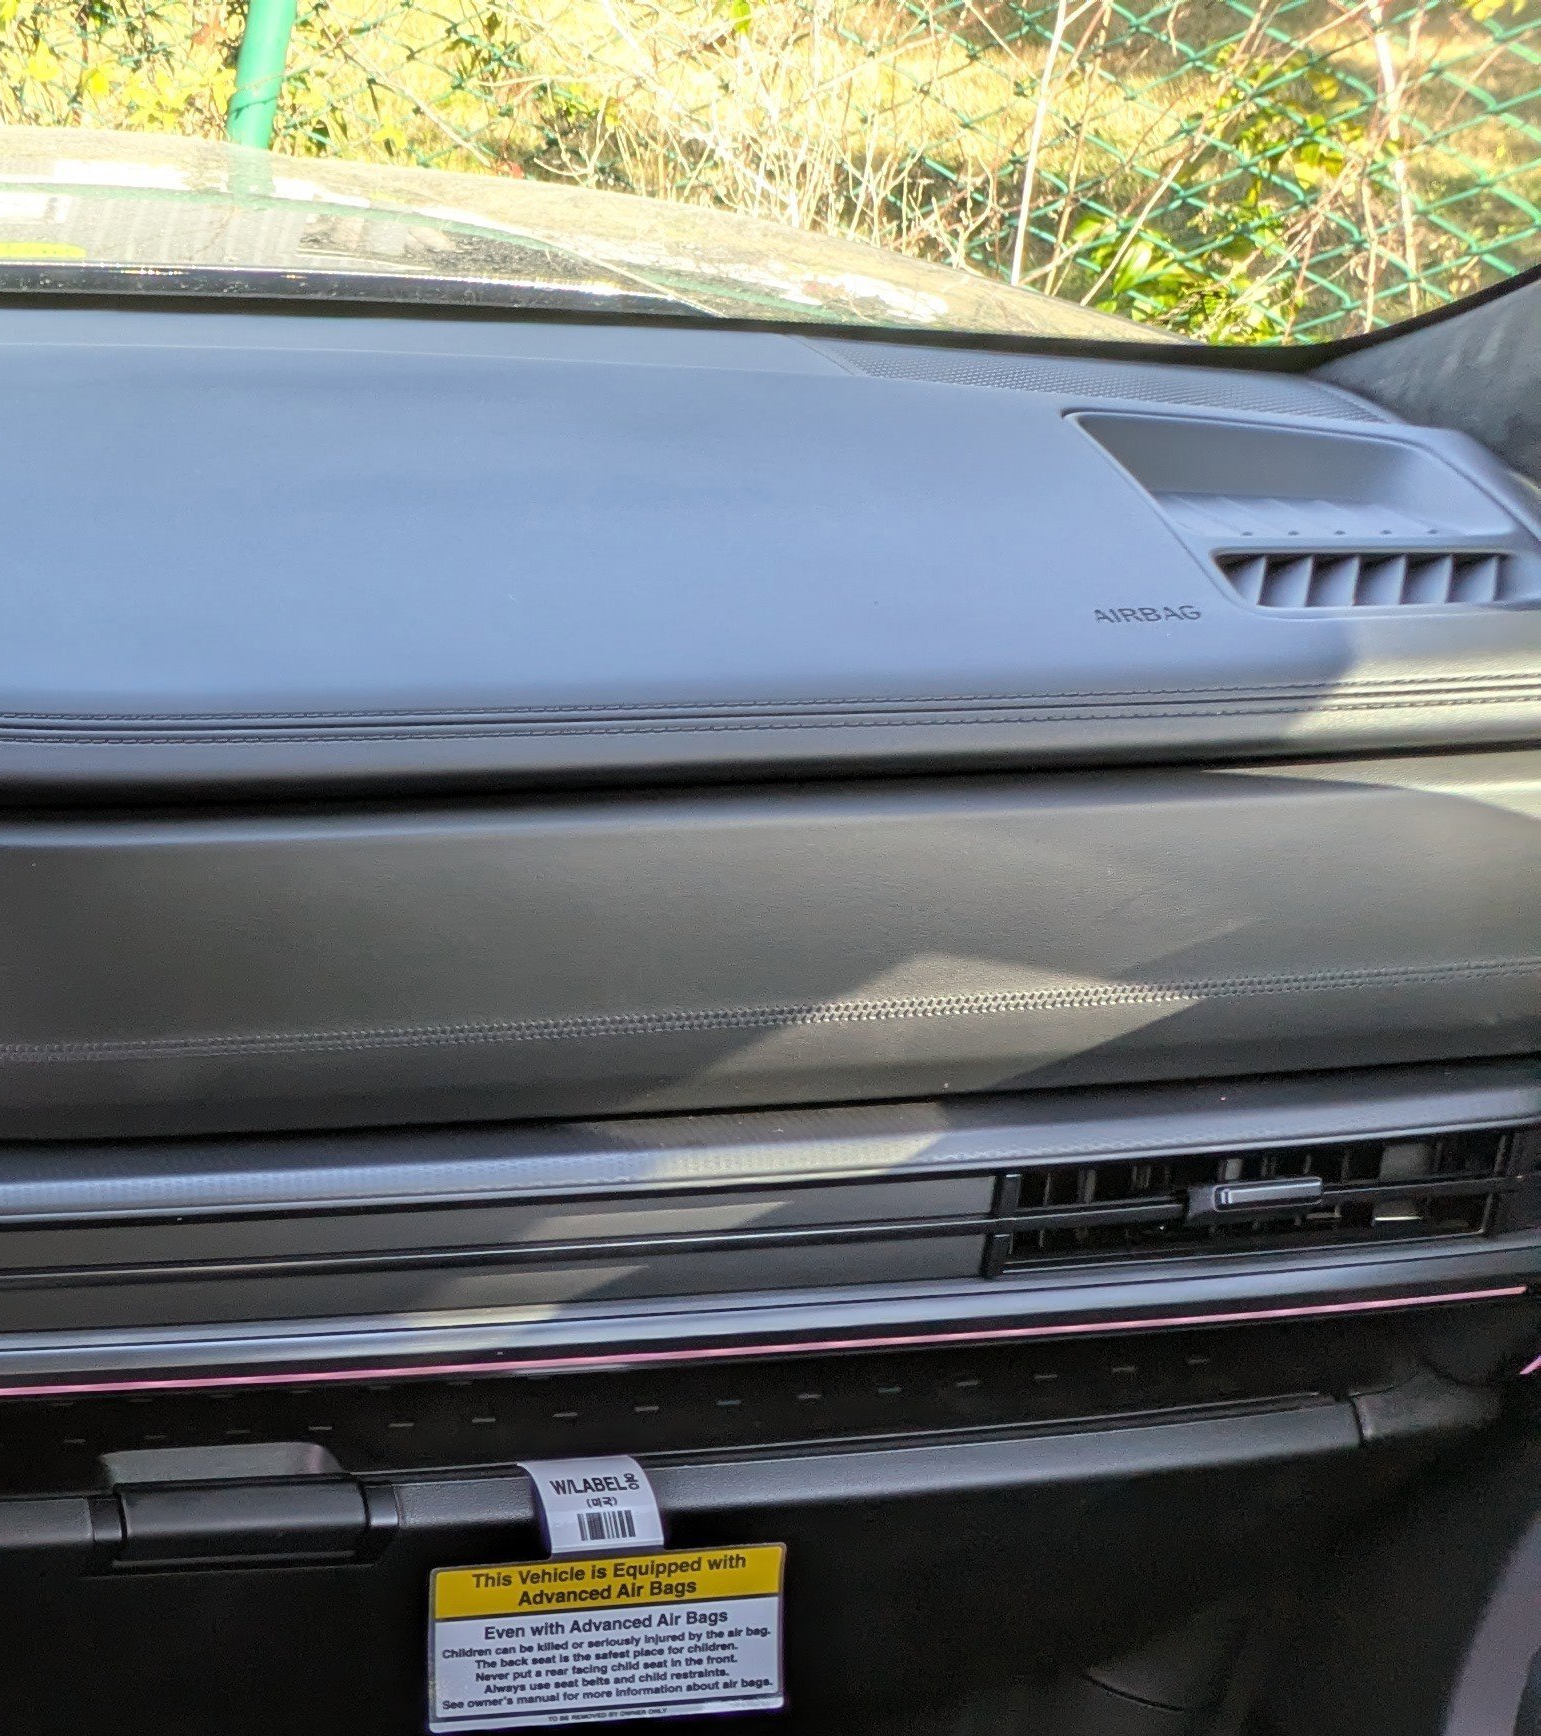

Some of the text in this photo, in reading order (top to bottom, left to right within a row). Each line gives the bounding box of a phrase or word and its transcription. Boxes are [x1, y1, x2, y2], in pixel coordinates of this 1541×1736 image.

[1093, 605, 1201, 625] AIRBAG
[472, 1554, 746, 1588] This Vehicle is Equipped with
[518, 1581, 697, 1606] Advanced Air Bags
[485, 1611, 728, 1640] Even with Advanced Air Bags
[442, 1627, 771, 1659] Children can be killed or seriously injured by the air bag.
[475, 1642, 738, 1669] The back seat is the safest place for children.
[475, 1654, 738, 1682] Never put a rear facing child seat in the front.
[484, 1669, 729, 1694] Always use seat belts and child restraints.
[442, 1678, 773, 1710] See owner's manual for more information about air bags.
